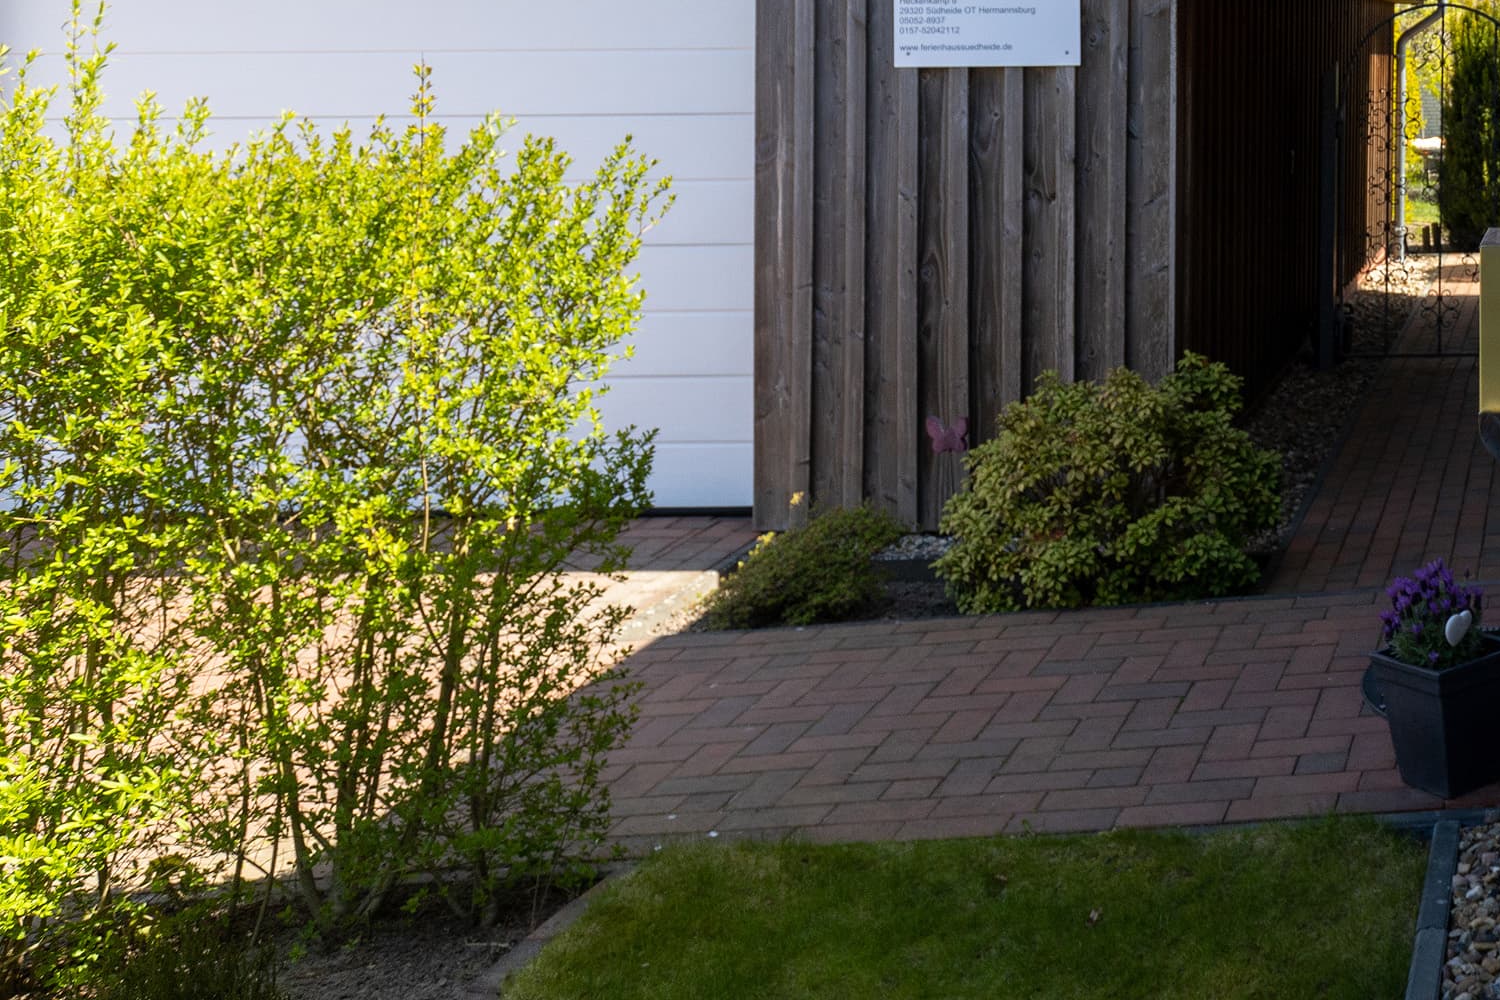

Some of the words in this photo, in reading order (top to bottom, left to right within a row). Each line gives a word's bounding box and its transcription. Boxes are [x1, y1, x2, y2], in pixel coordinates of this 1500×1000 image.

[926, 6, 962, 14] Südheide
[964, 6, 976, 14] OT
[978, 6, 1036, 16] Hermannsburg
